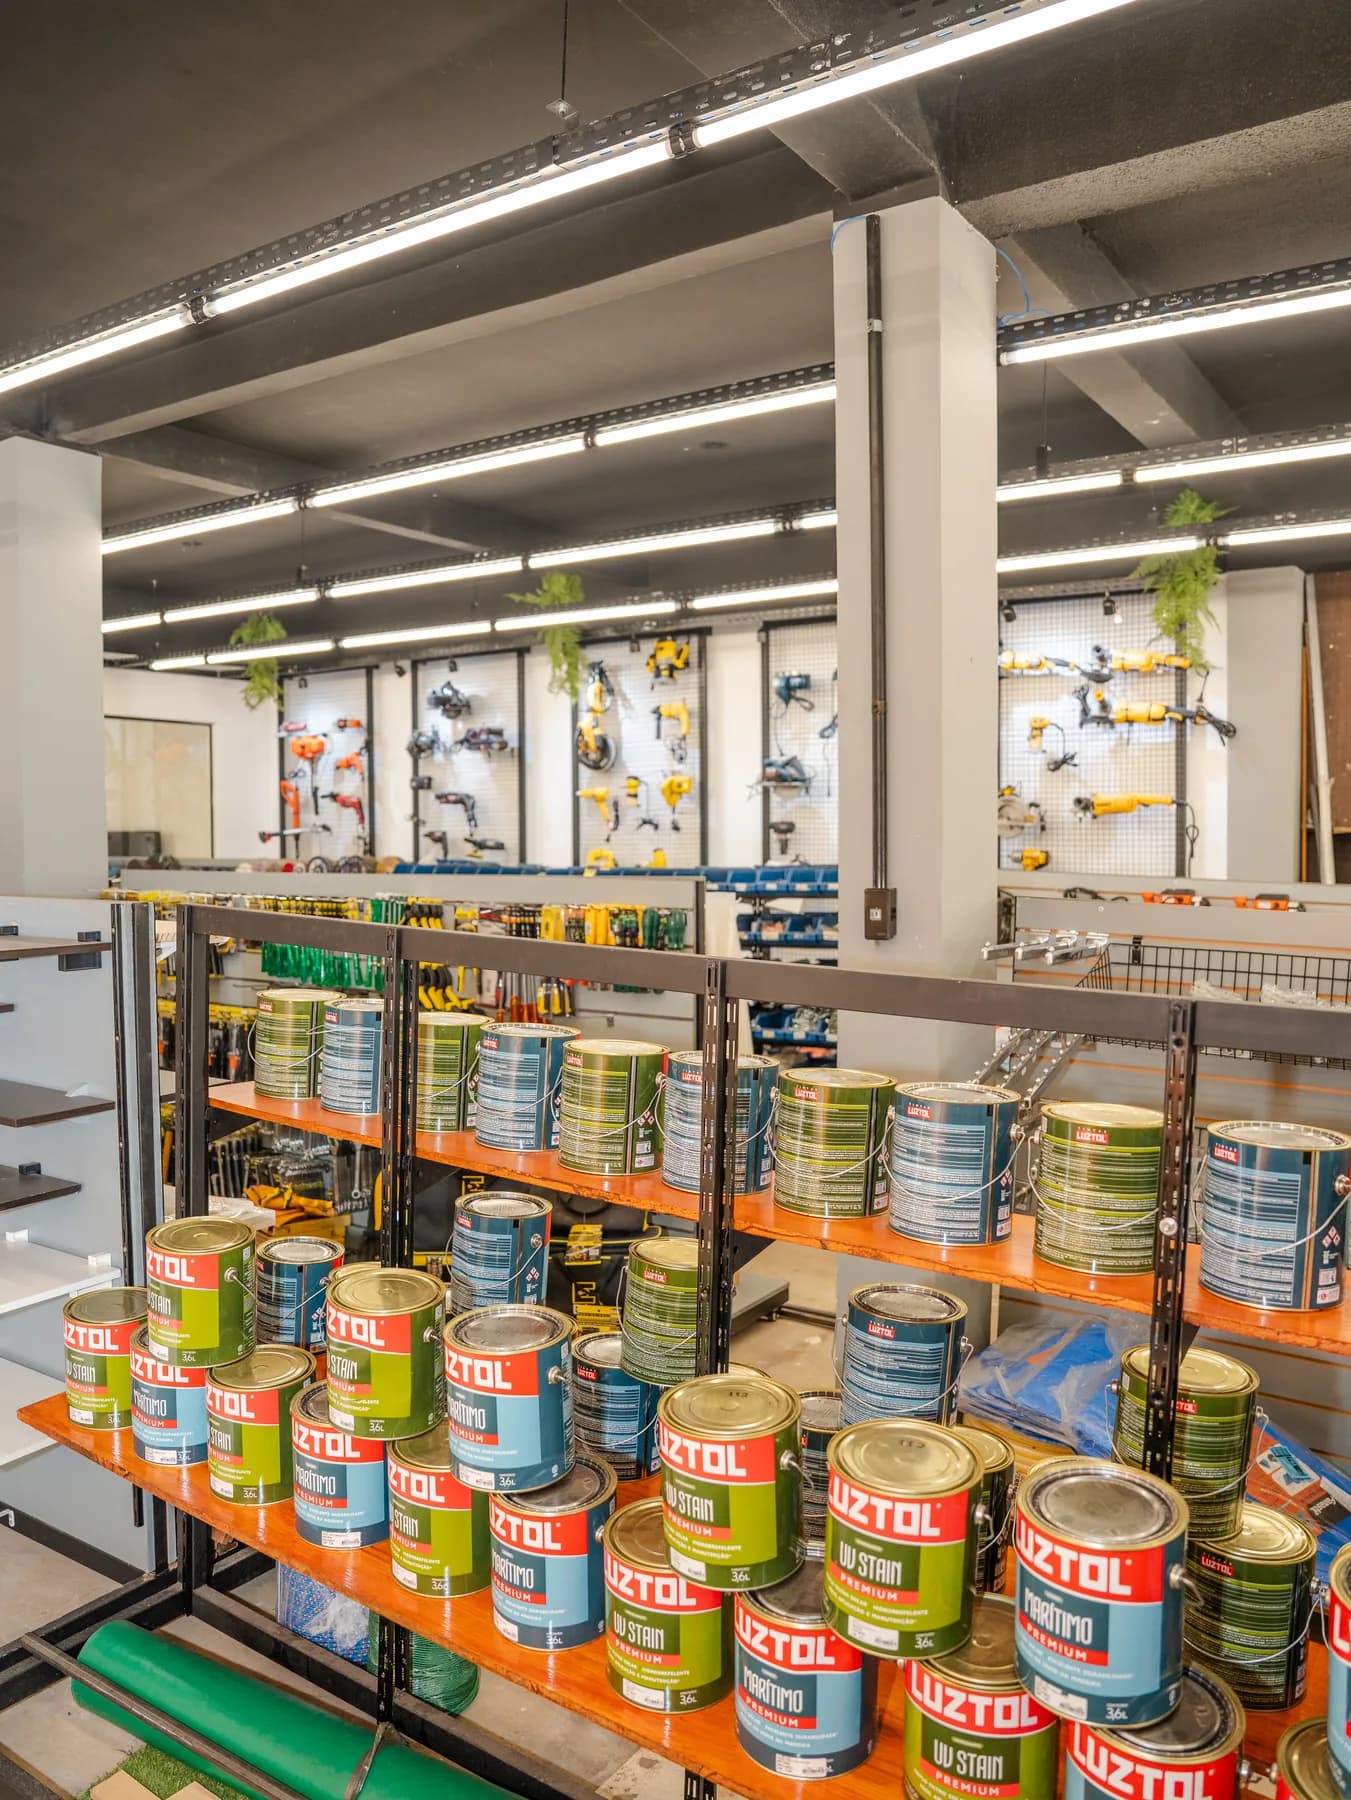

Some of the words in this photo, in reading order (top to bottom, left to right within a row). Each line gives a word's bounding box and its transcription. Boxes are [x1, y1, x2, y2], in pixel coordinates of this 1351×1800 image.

[1076, 1130, 1107, 1144] LUZTOL
[868, 1323, 896, 1339] LUZTOL
[330, 1354, 358, 1380] STAIN
[295, 1463, 336, 1495] MARÍTIMO
[297, 1487, 333, 1508] PREMIUM
[678, 1490, 714, 1523] STAIN
[394, 1509, 419, 1538] STAIN
[668, 1510, 712, 1537] PREMIUM
[605, 1552, 697, 1606] UZTOL
[839, 1541, 856, 1575] UV
[858, 1551, 902, 1586] STAIN
[1201, 1555, 1234, 1577] LUZTOL
[493, 1575, 532, 1602] PREMIUM
[840, 1572, 899, 1602] PREMIUM
[613, 1611, 626, 1637] UV
[628, 1621, 665, 1650] STAIN
[1024, 1587, 1093, 1646] MARÍTIMO
[737, 1606, 836, 1665] UZTOL
[1026, 1623, 1088, 1662] PREMIUM
[615, 1639, 663, 1665] PREMIUM
[743, 1665, 803, 1713] MARÍTIMO
[911, 1659, 1038, 1729] LUZTOL
[746, 1695, 799, 1728] PREMIUM
[1105, 1707, 1129, 1721] 3,6L
[934, 1738, 954, 1768] UV
[956, 1750, 1004, 1781] STAIN
[1073, 1721, 1214, 1800] LUZTOL
[935, 1770, 1000, 1796] PREMIUM
